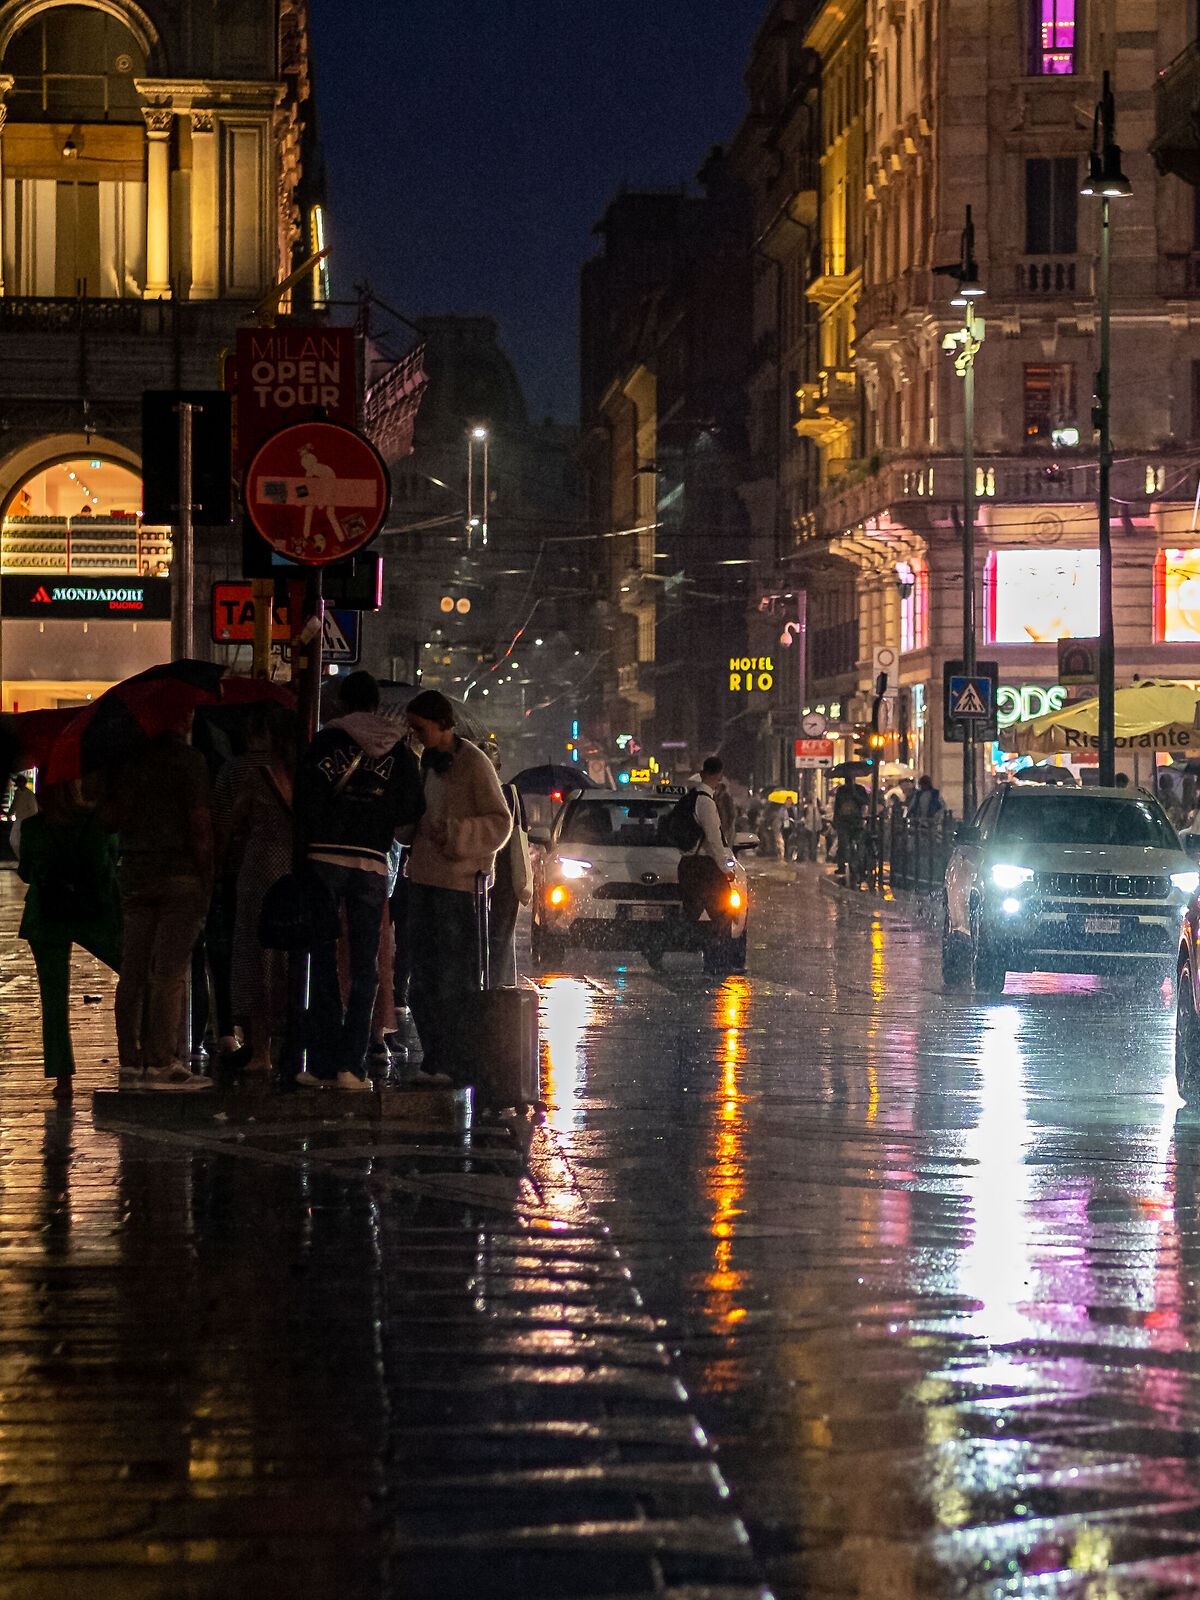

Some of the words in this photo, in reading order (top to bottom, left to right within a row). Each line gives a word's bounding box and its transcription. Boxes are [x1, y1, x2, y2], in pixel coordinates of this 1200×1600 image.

[250, 335, 341, 360] MILAN
[250, 360, 341, 385] OPEN
[252, 385, 341, 409] TOUR
[52, 588, 144, 601] MONDADORI
[109, 601, 144, 610] DUOMO
[220, 600, 290, 625] TA
[729, 656, 774, 671] HOTEL
[729, 672, 773, 691] RIO
[1064, 726, 1190, 748] Risorante
[658, 786, 684, 795] TAXI
